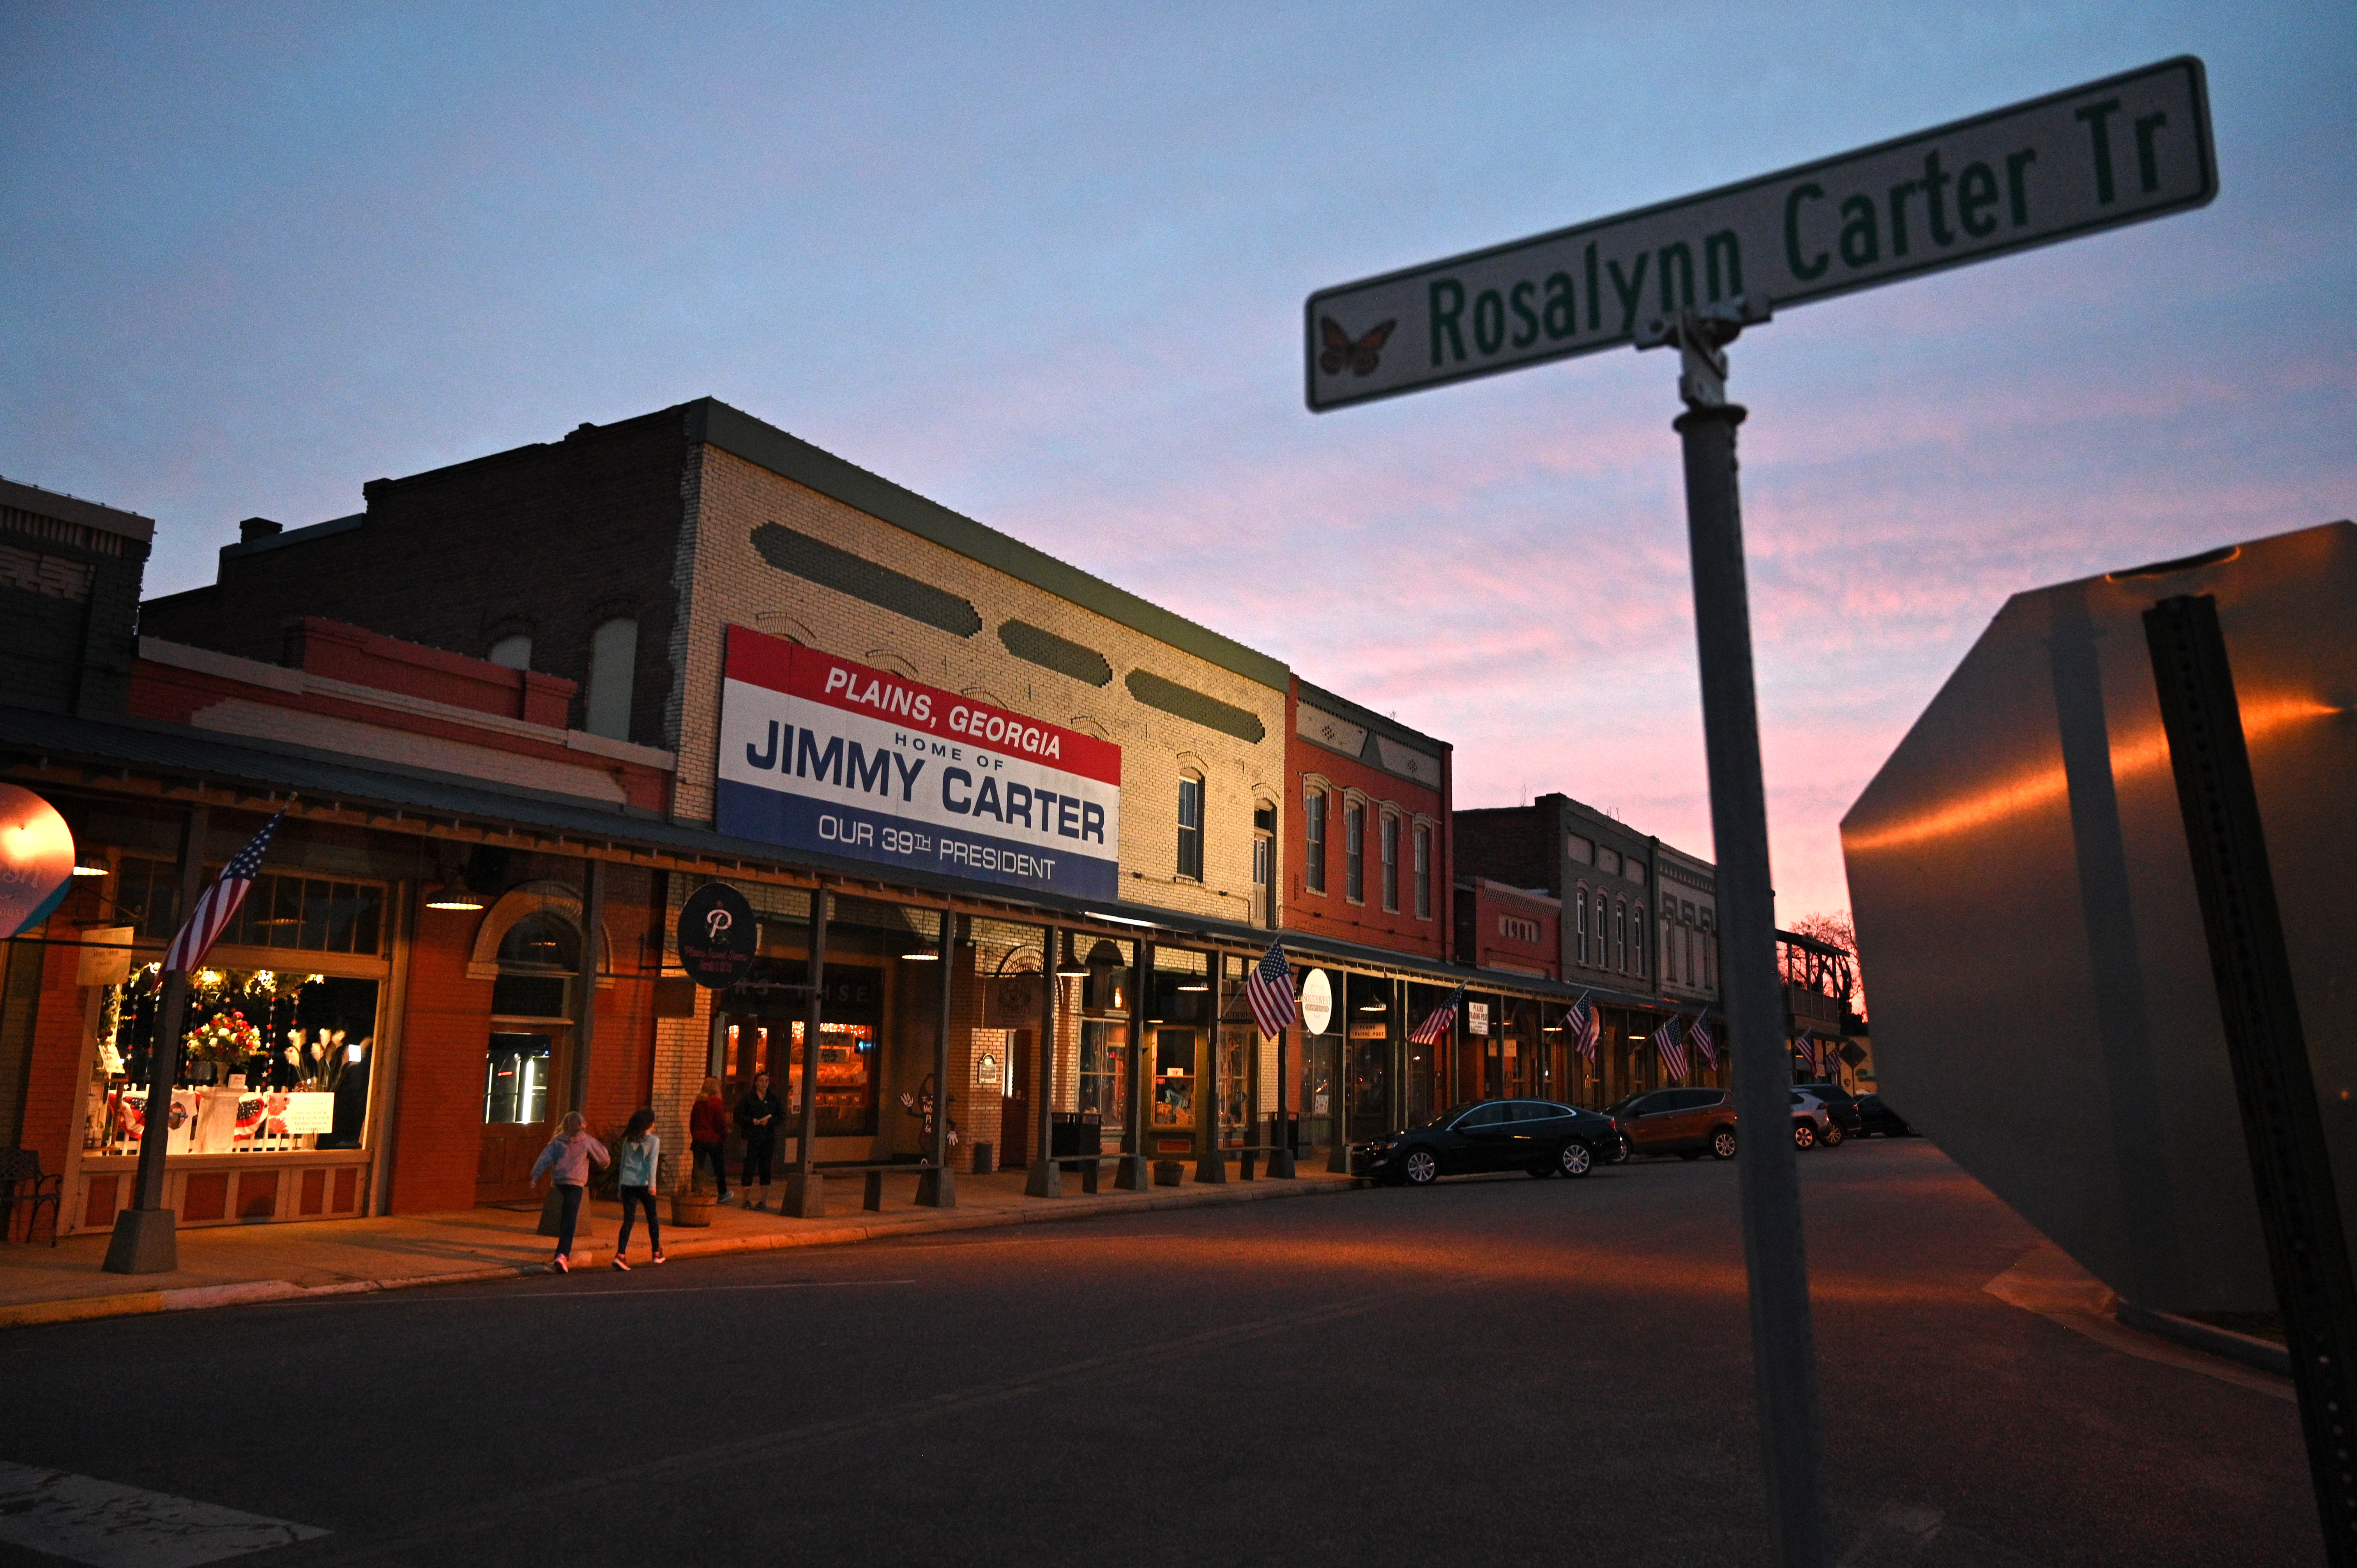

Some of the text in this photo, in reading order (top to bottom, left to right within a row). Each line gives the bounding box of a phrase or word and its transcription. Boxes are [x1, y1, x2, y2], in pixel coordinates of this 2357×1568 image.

[1426, 97, 2167, 367] Rosalynn Carter Tr
[825, 667, 1060, 759] PLAINS, GEORGIA
[746, 720, 1104, 844] JIMMY CARTER
[895, 732, 1004, 770] HOME OF
[818, 814, 1055, 879] OUR 39TH PRESIDENT
[1303, 993, 1330, 1005] SOUTHWEST
[1473, 1004, 1483, 1012] PLAINS
